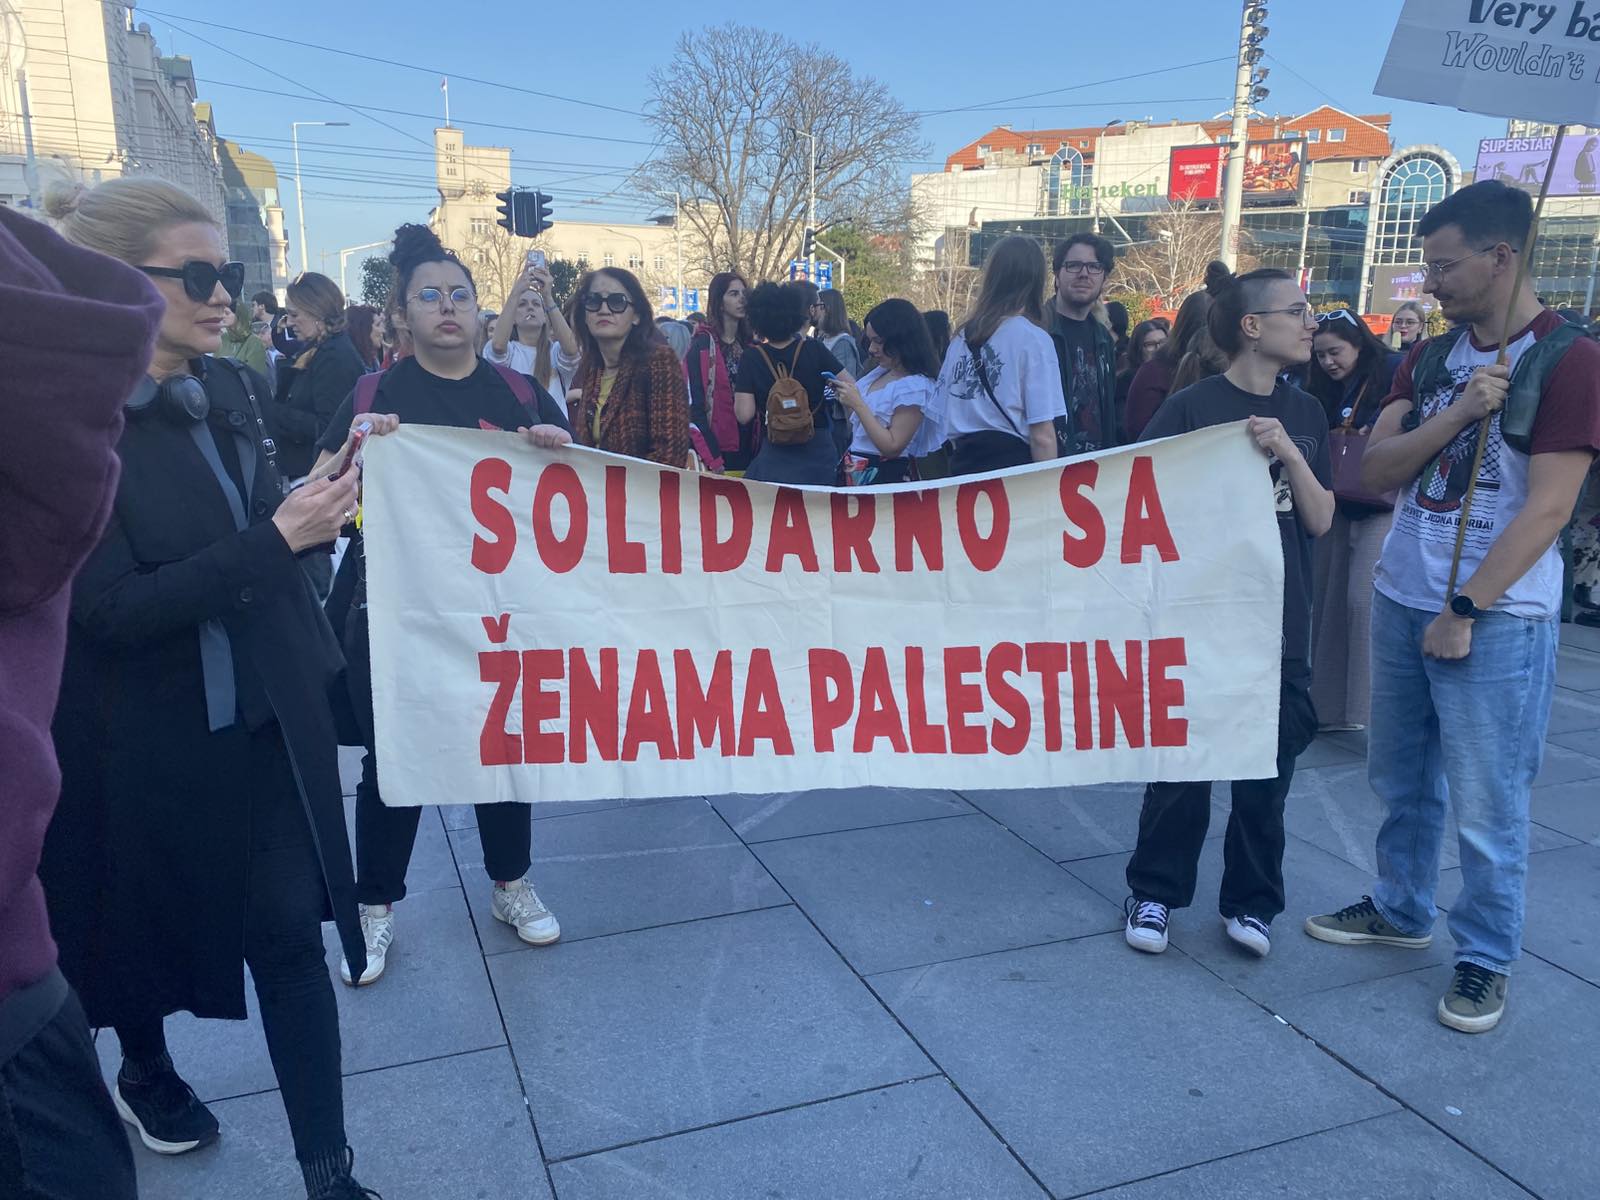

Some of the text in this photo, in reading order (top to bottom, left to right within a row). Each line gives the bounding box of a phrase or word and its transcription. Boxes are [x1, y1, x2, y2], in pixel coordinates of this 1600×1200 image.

[1469, 0, 1557, 34] Very
[1442, 31, 1585, 81] Wouldn't
[1480, 137, 1553, 153] SUPERSTAR
[470, 456, 1180, 574] SOLIDARNO SA
[1454, 517, 1495, 531] BRBA!
[478, 613, 1189, 766] ŽENAMA PALESTINE
